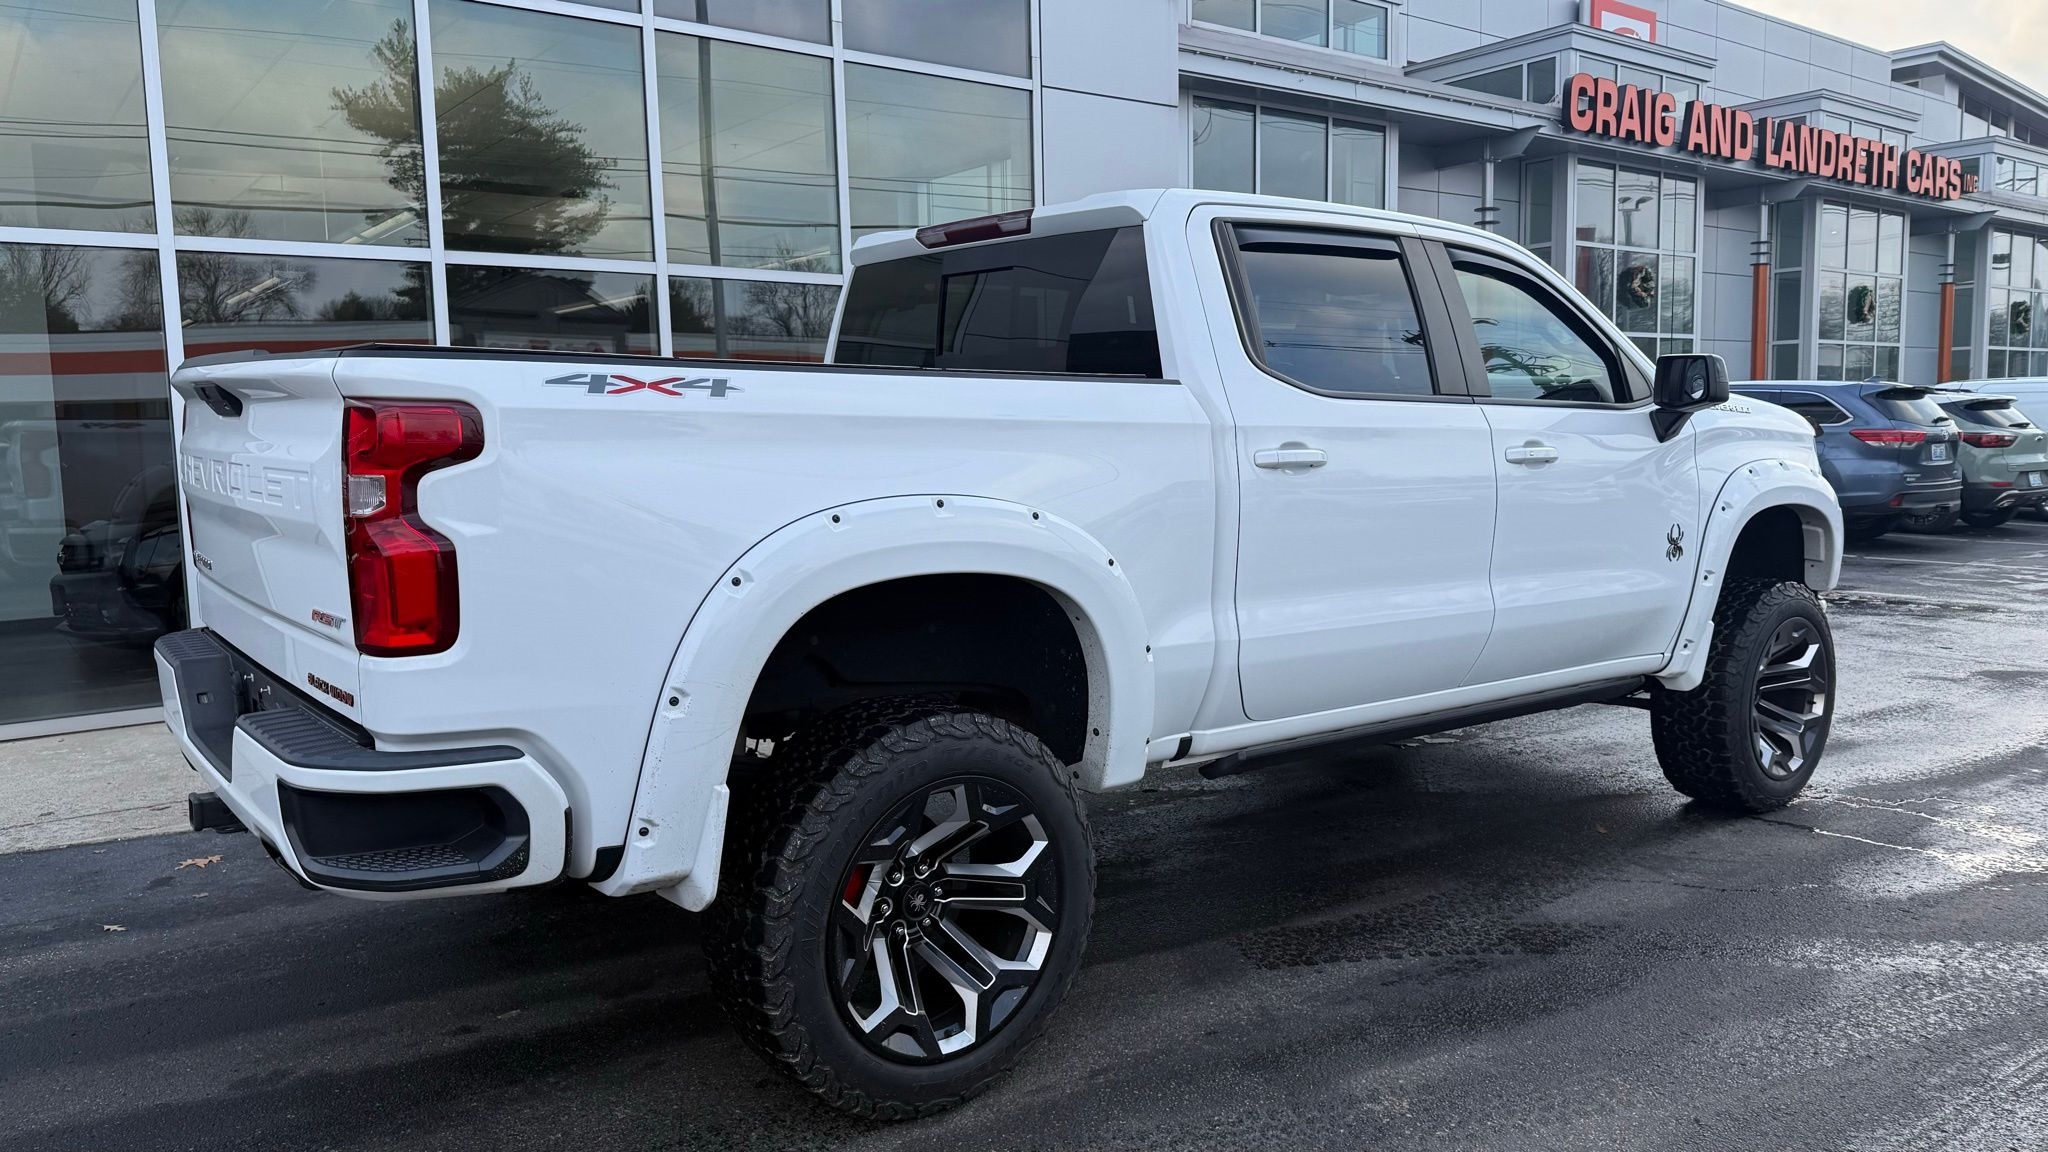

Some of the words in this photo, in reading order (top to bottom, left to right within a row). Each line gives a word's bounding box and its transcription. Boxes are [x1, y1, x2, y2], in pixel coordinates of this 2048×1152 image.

[1568, 72, 1677, 147] CRAIG
[1686, 100, 1754, 161] AND
[1764, 117, 1899, 189] LANDRETH
[1906, 148, 1962, 200] CARS
[311, 609, 347, 630] RST
